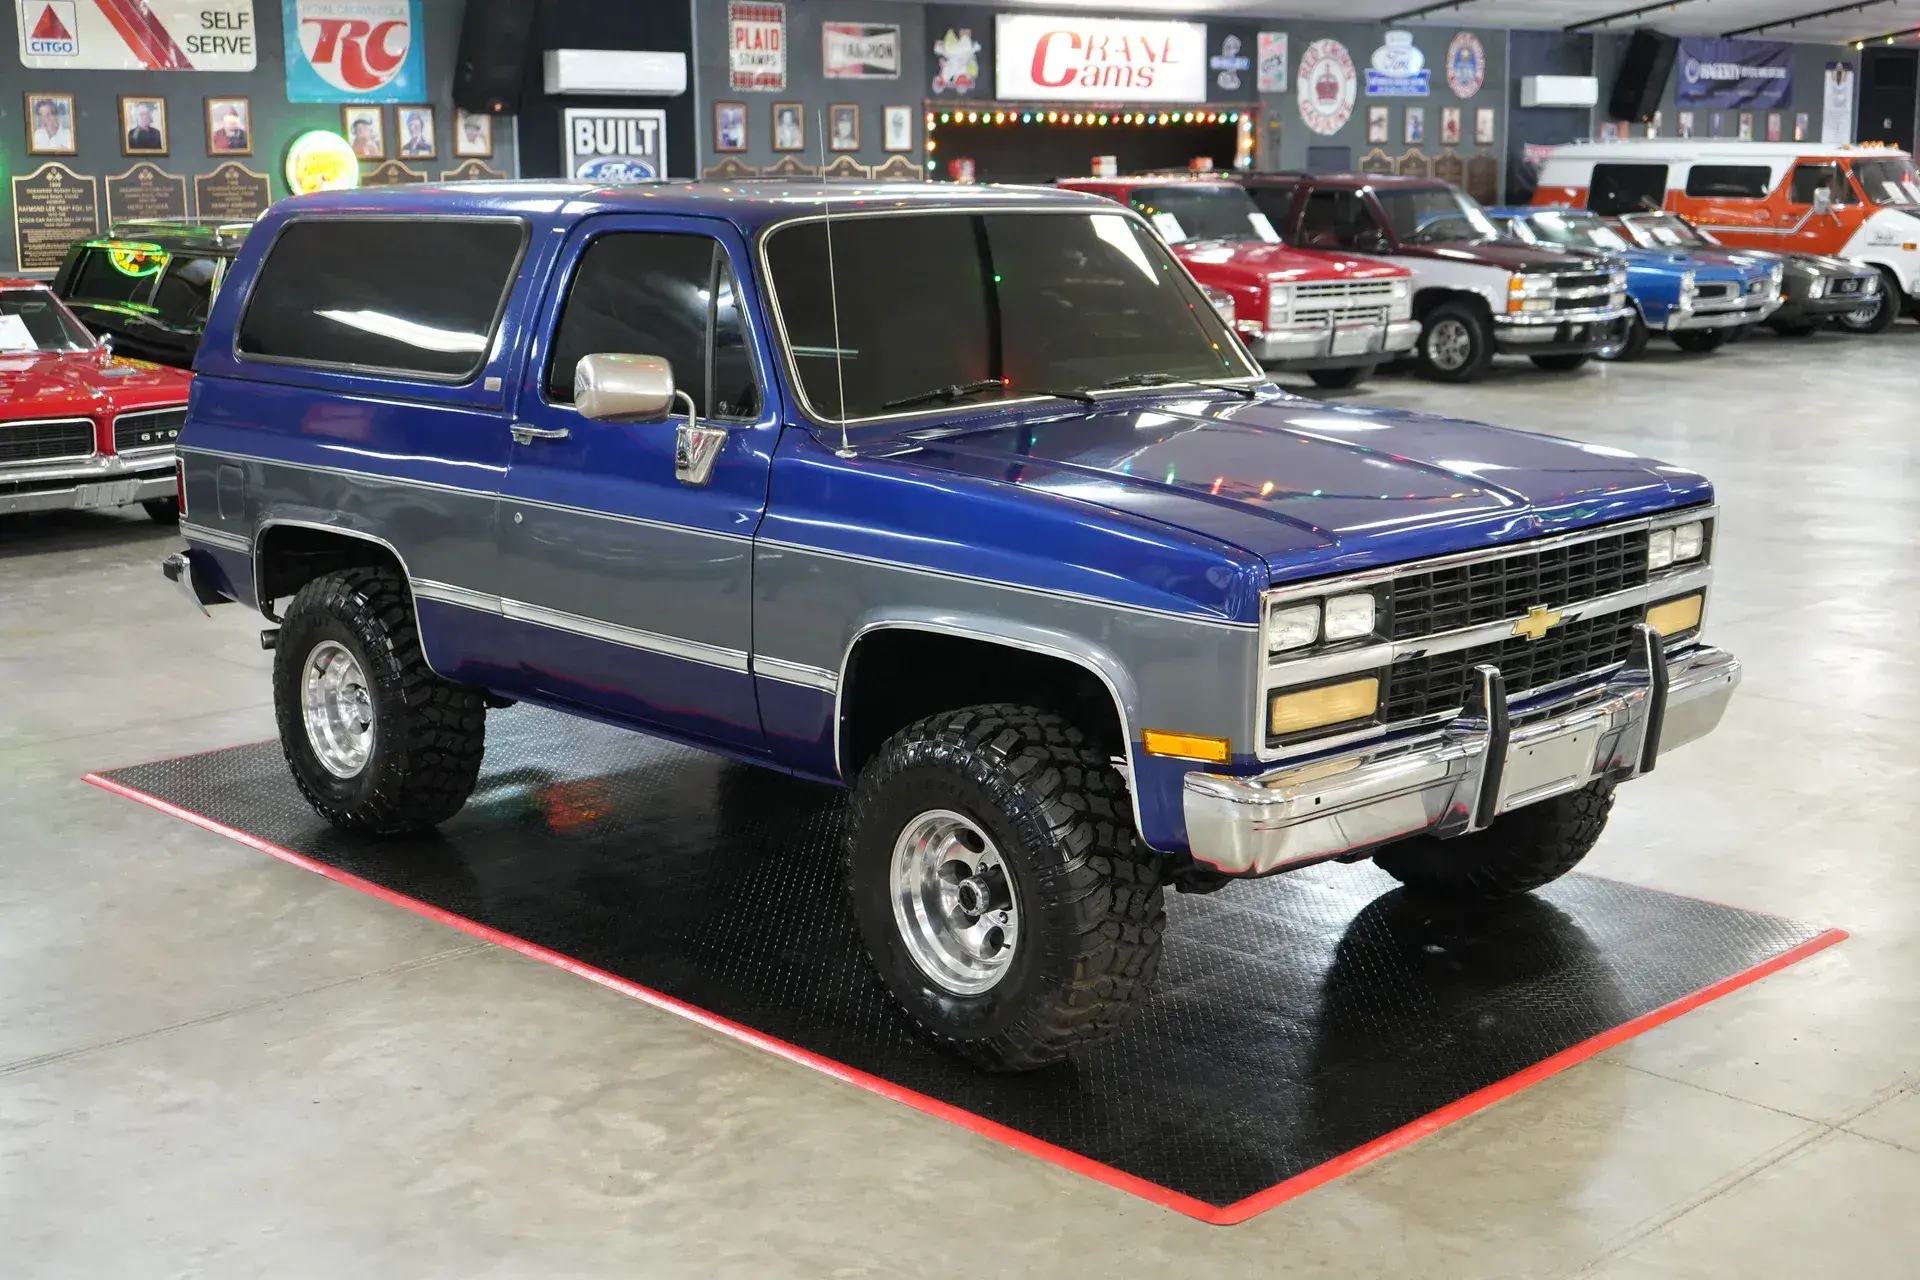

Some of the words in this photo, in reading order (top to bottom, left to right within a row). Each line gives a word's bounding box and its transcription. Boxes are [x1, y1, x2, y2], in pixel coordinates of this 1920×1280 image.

[200, 11, 249, 30] SELF
[31, 41, 73, 53] CITGO
[185, 35, 252, 54] SERVE
[735, 27, 781, 52] PLAID
[302, 18, 408, 89] RC
[574, 118, 658, 155] BUILT
[141, 429, 178, 441] GTO
